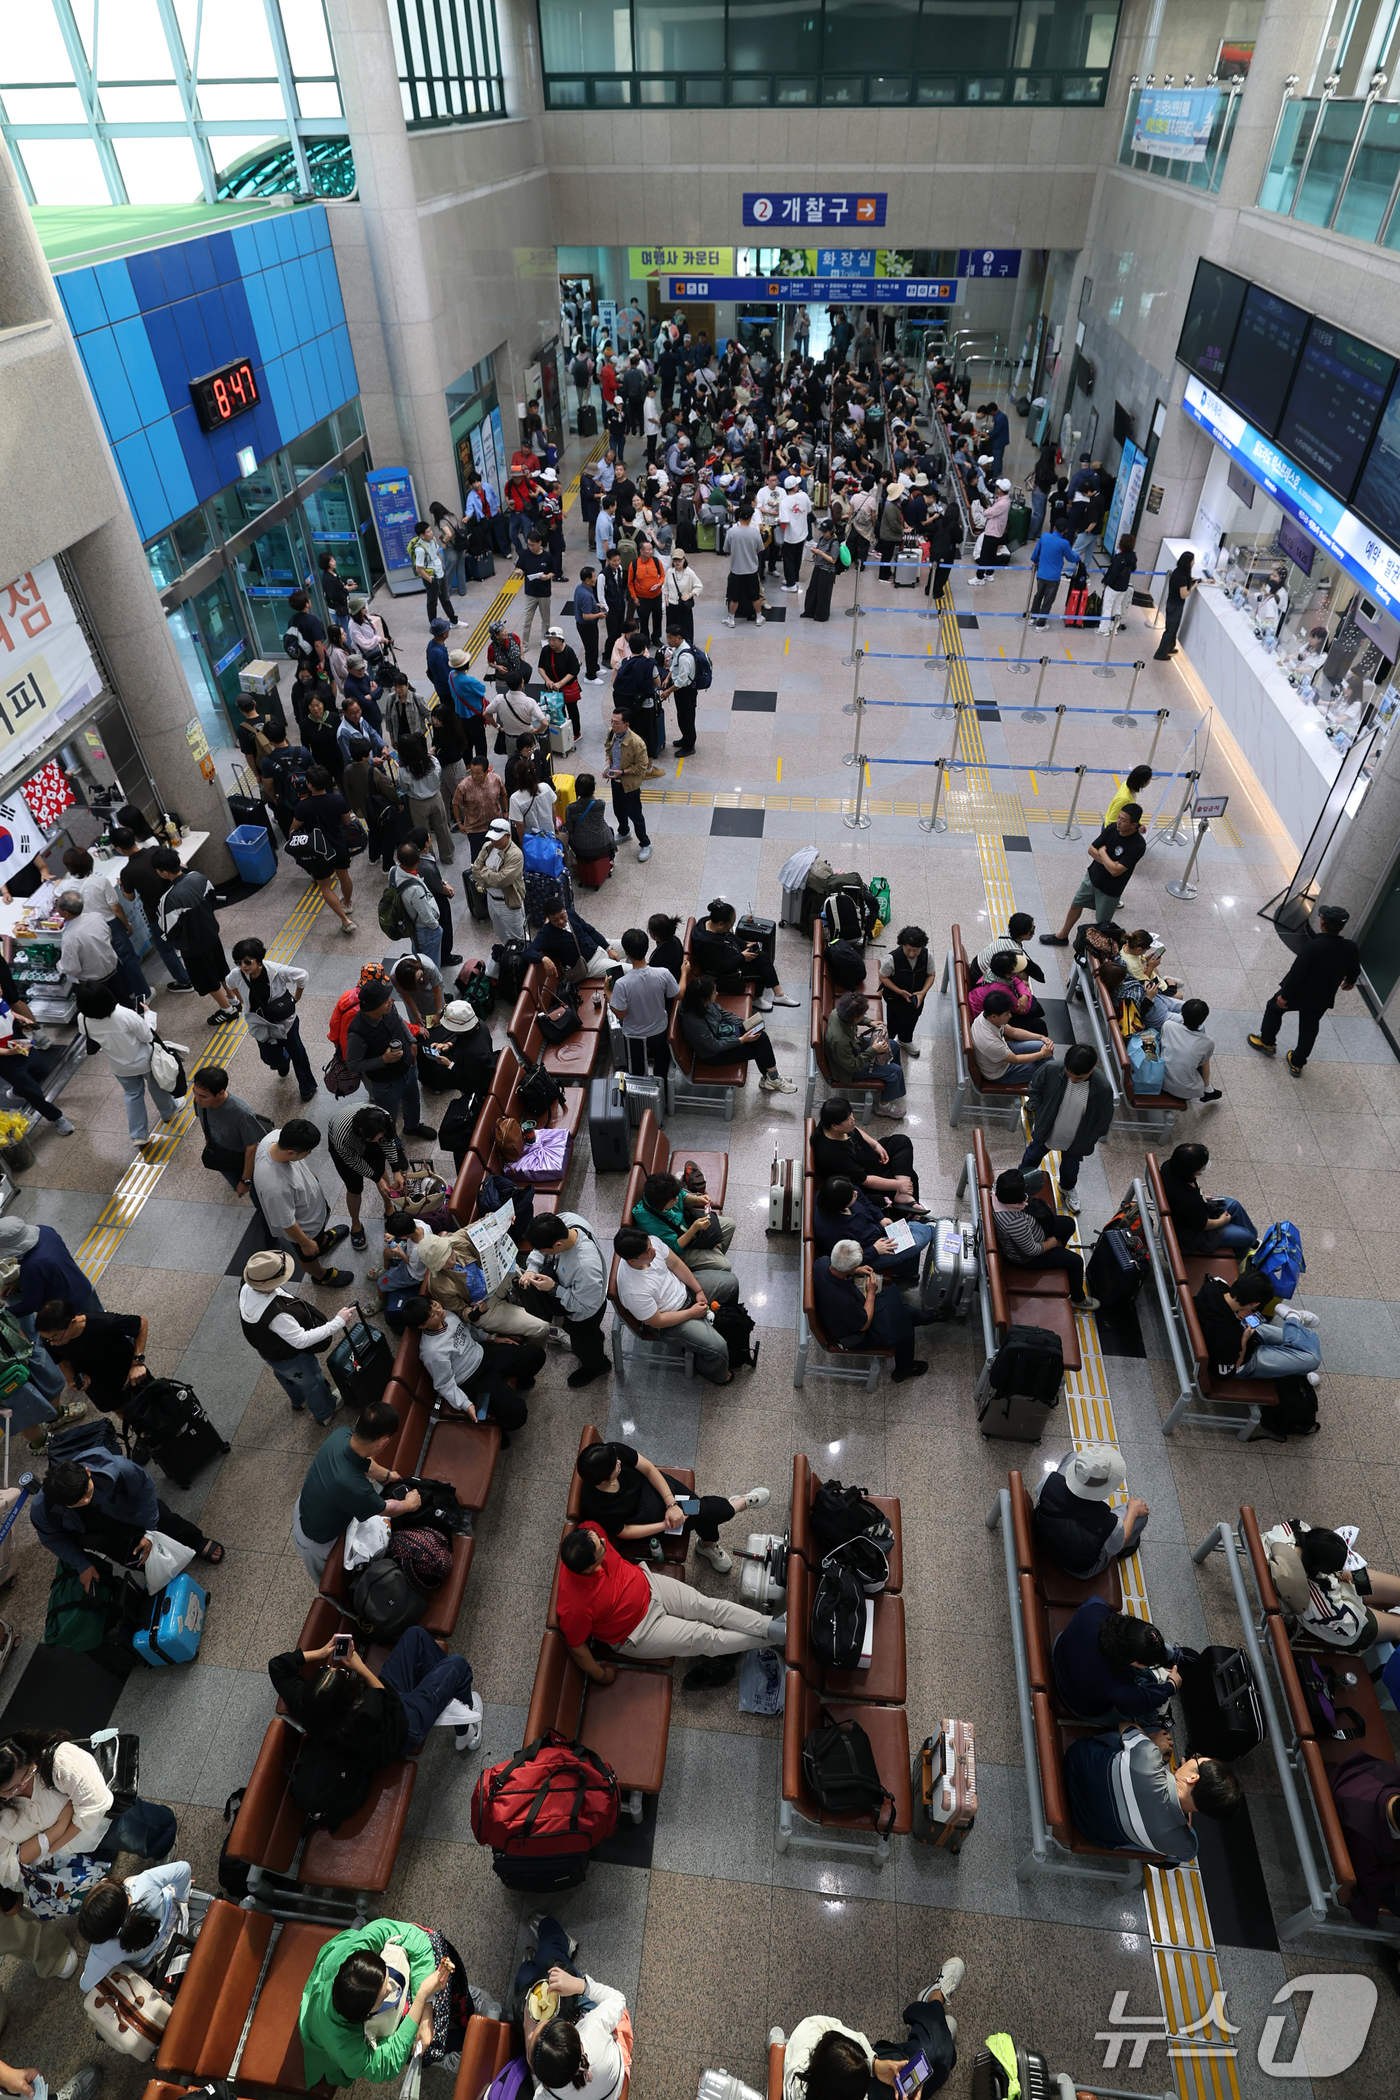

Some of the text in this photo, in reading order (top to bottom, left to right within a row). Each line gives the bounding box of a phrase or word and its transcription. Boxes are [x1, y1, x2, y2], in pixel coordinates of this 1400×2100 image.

[781, 197, 849, 223] 개찰구
[641, 250, 720, 266] 여행사 카운터
[822, 251, 872, 267] 화장실
[213, 365, 257, 419] 8:47
[1365, 540, 1382, 566] 예약
